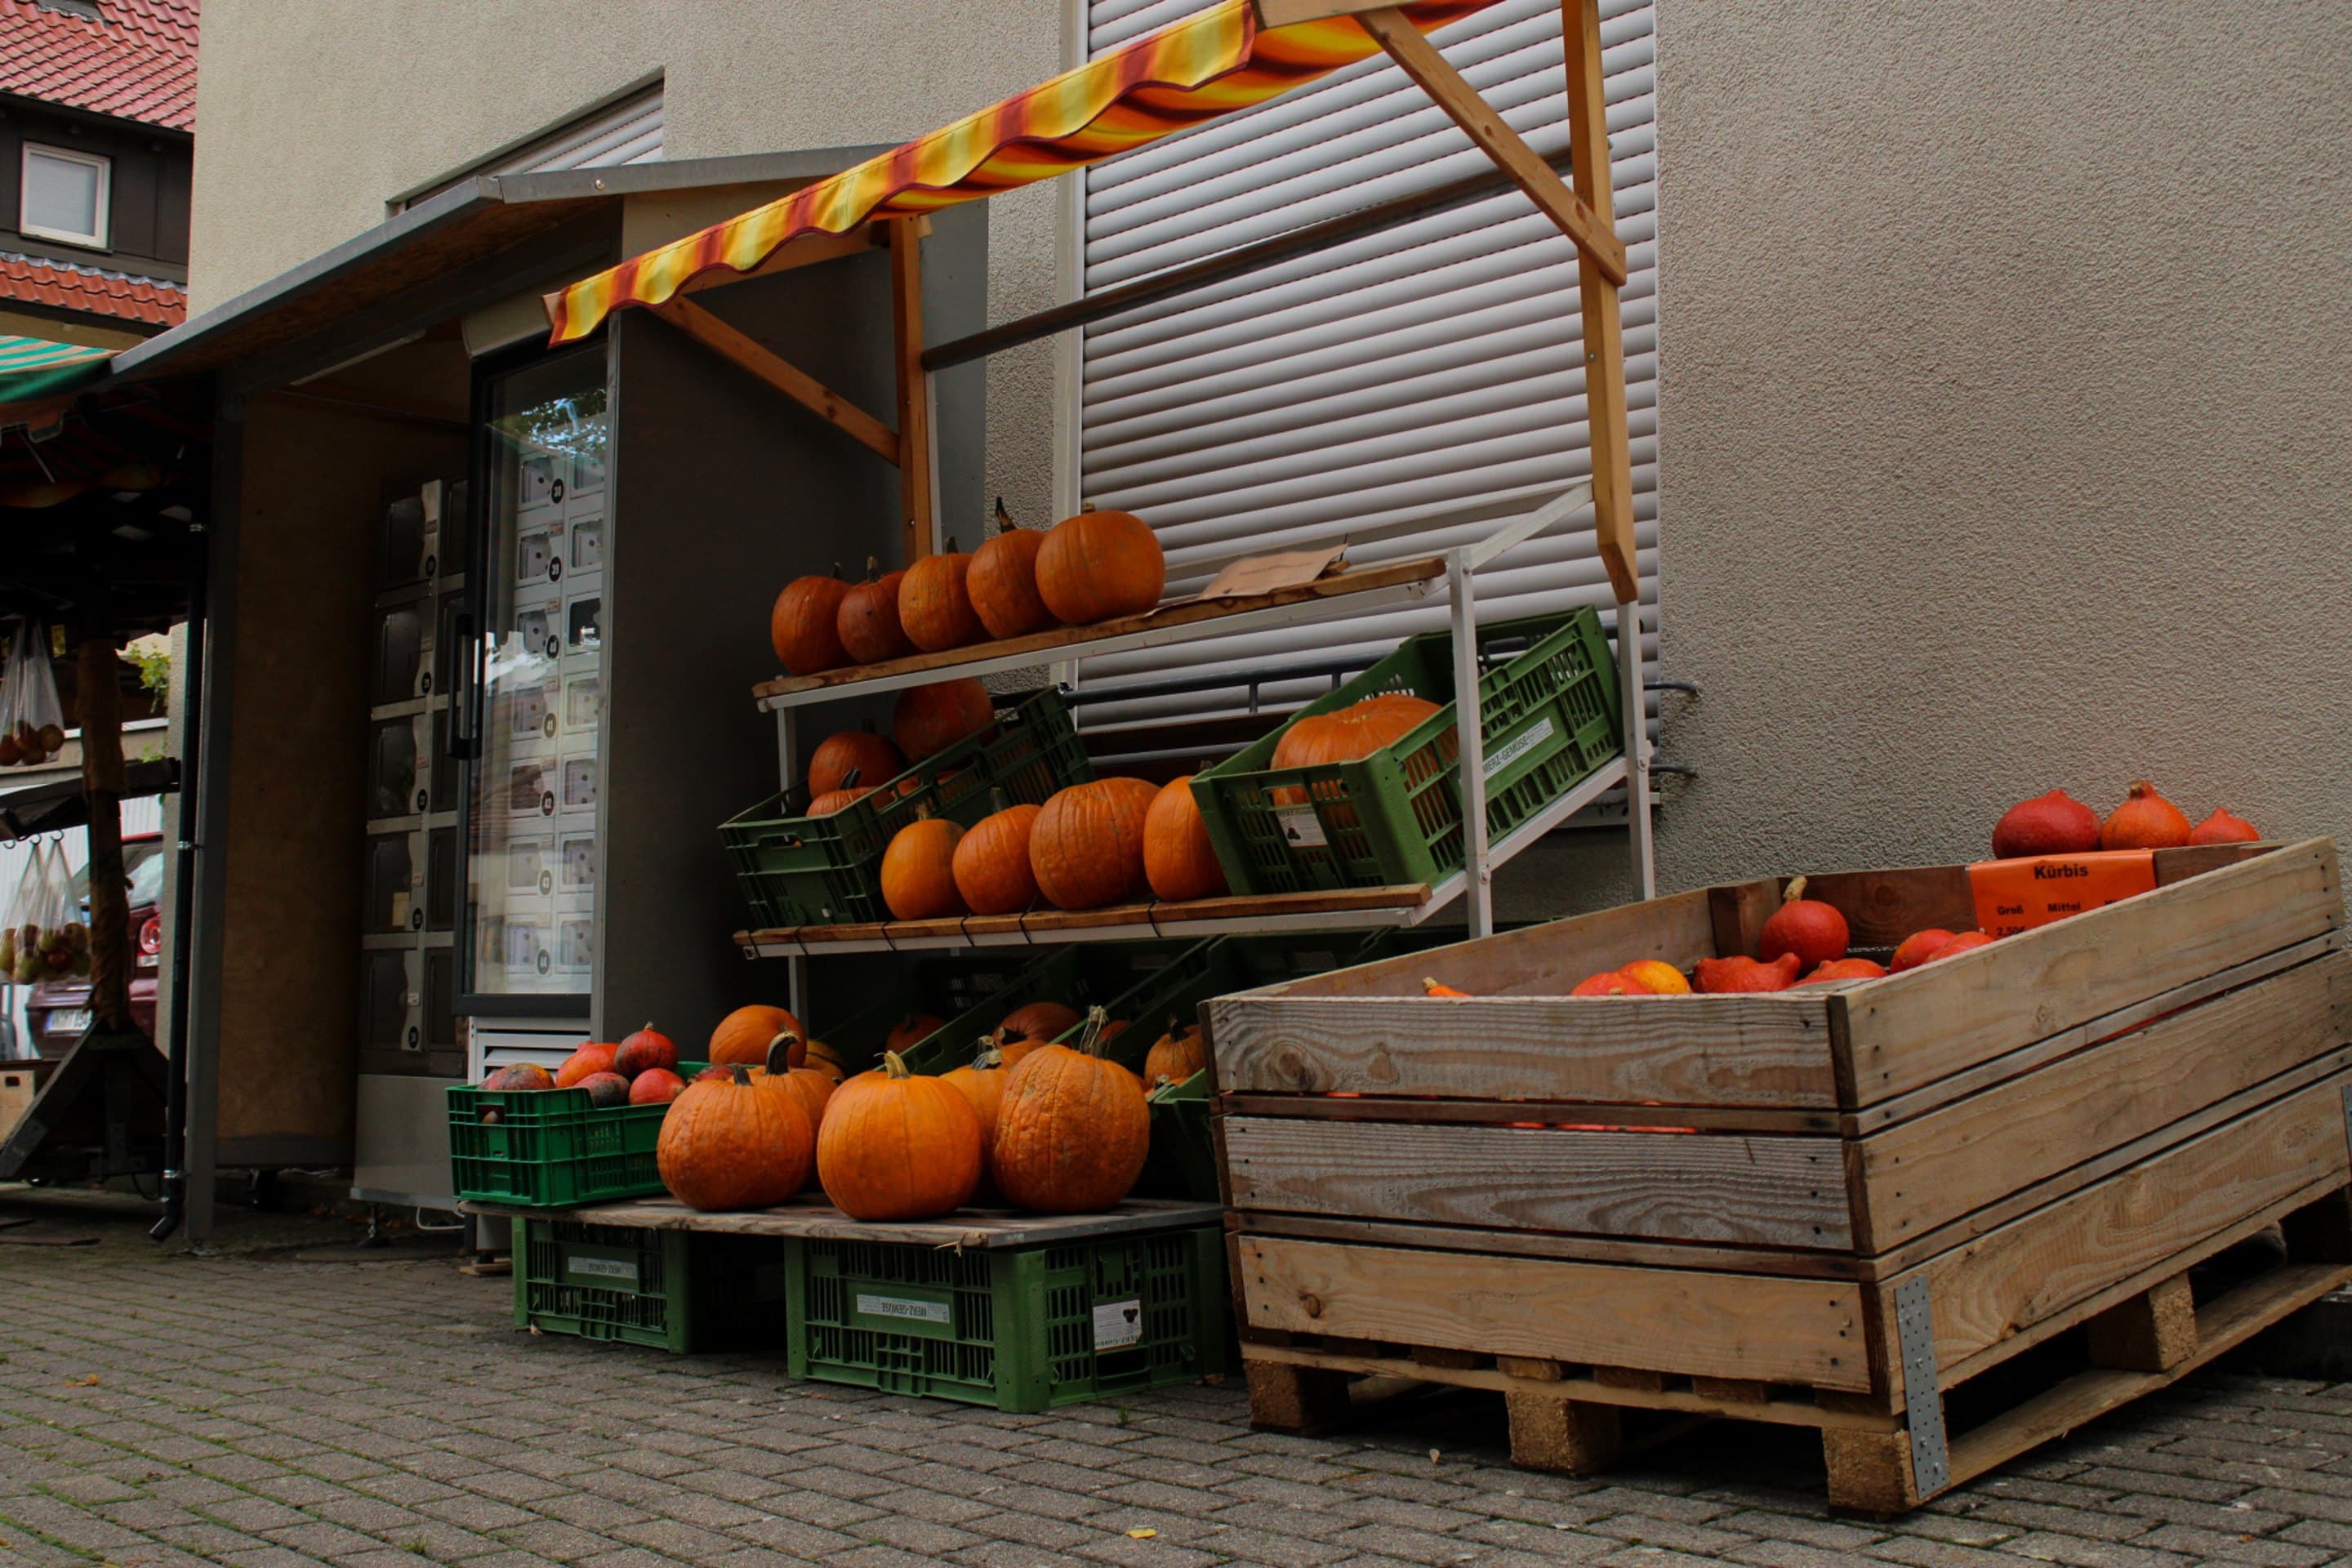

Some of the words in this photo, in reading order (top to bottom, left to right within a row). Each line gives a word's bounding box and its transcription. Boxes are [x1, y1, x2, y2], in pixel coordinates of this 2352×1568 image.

[2034, 863, 2089, 880] Kürbis
[1997, 904, 2025, 915] Groß
[2047, 901, 2081, 912] Mittel
